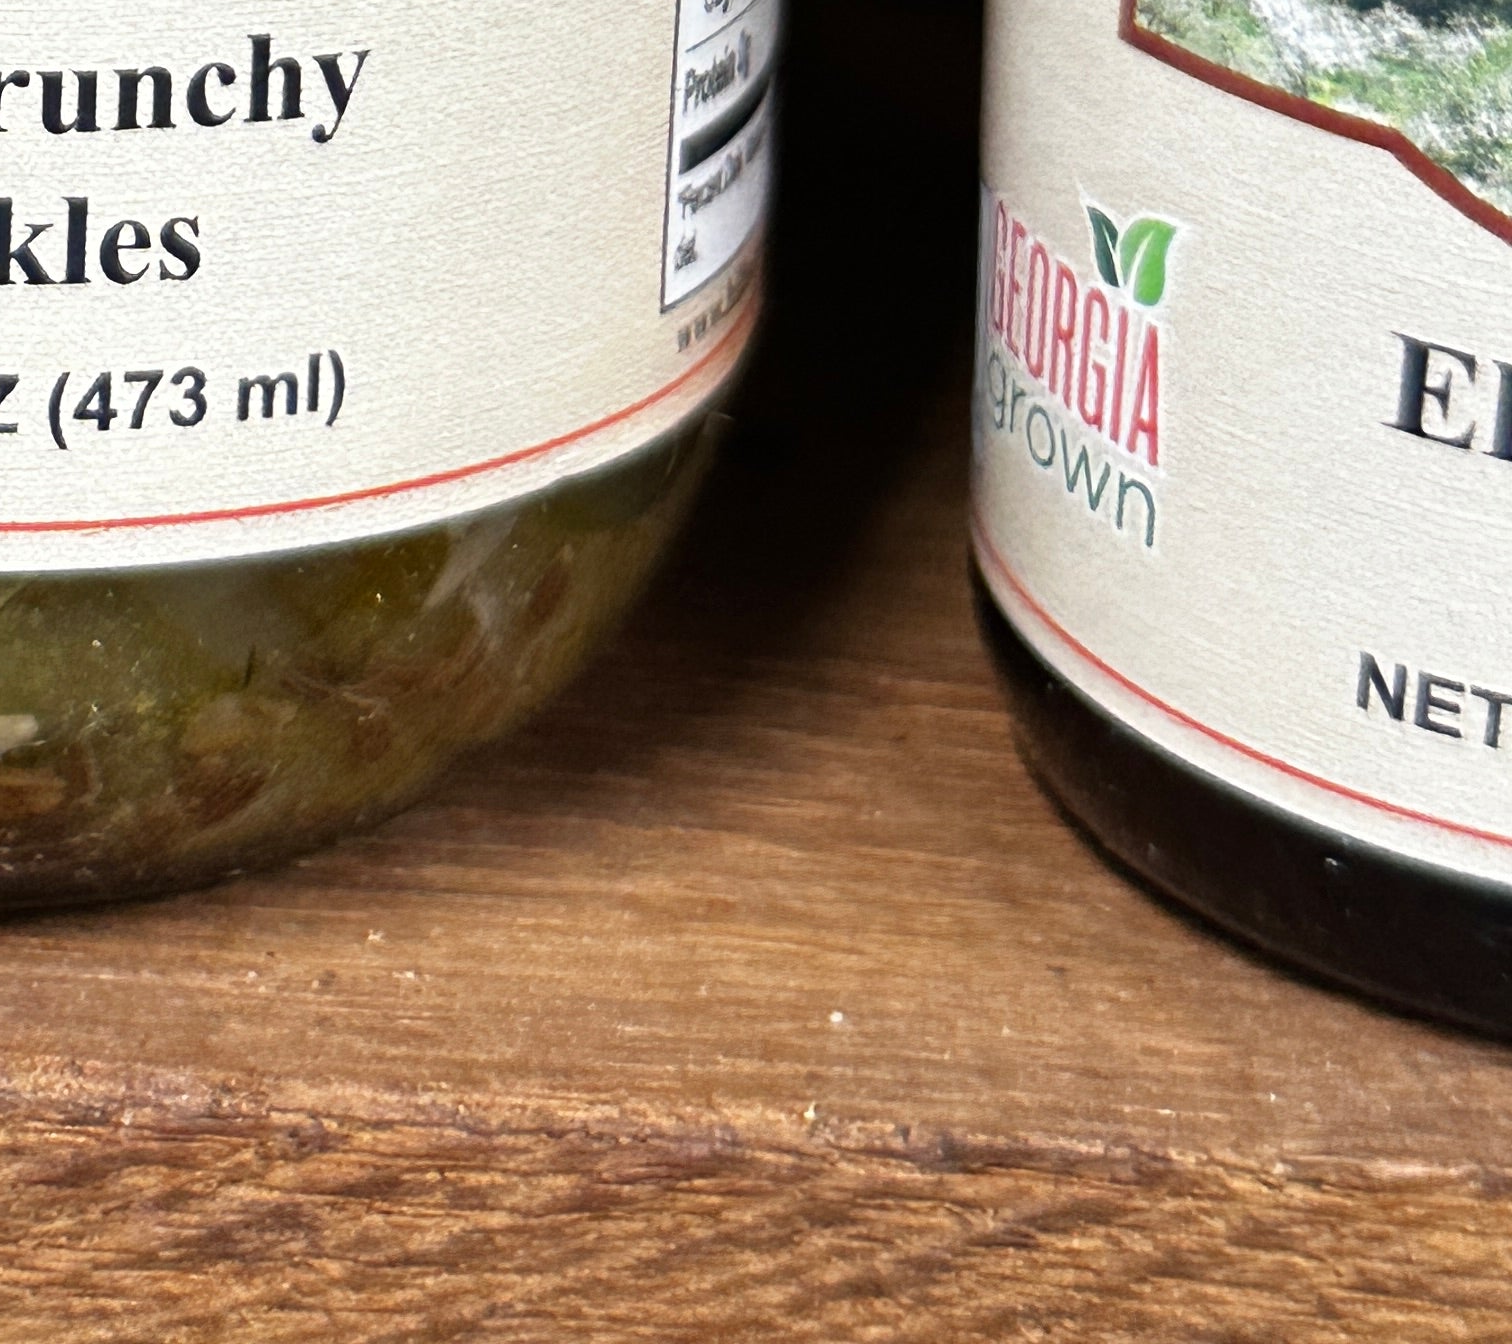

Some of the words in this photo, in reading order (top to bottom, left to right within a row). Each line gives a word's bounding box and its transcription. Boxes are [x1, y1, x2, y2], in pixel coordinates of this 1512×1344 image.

[48, 366, 208, 451] (473
[236, 349, 347, 428] ml)
[992, 199, 1158, 467] GEORGIA
[988, 349, 1157, 548] grown
